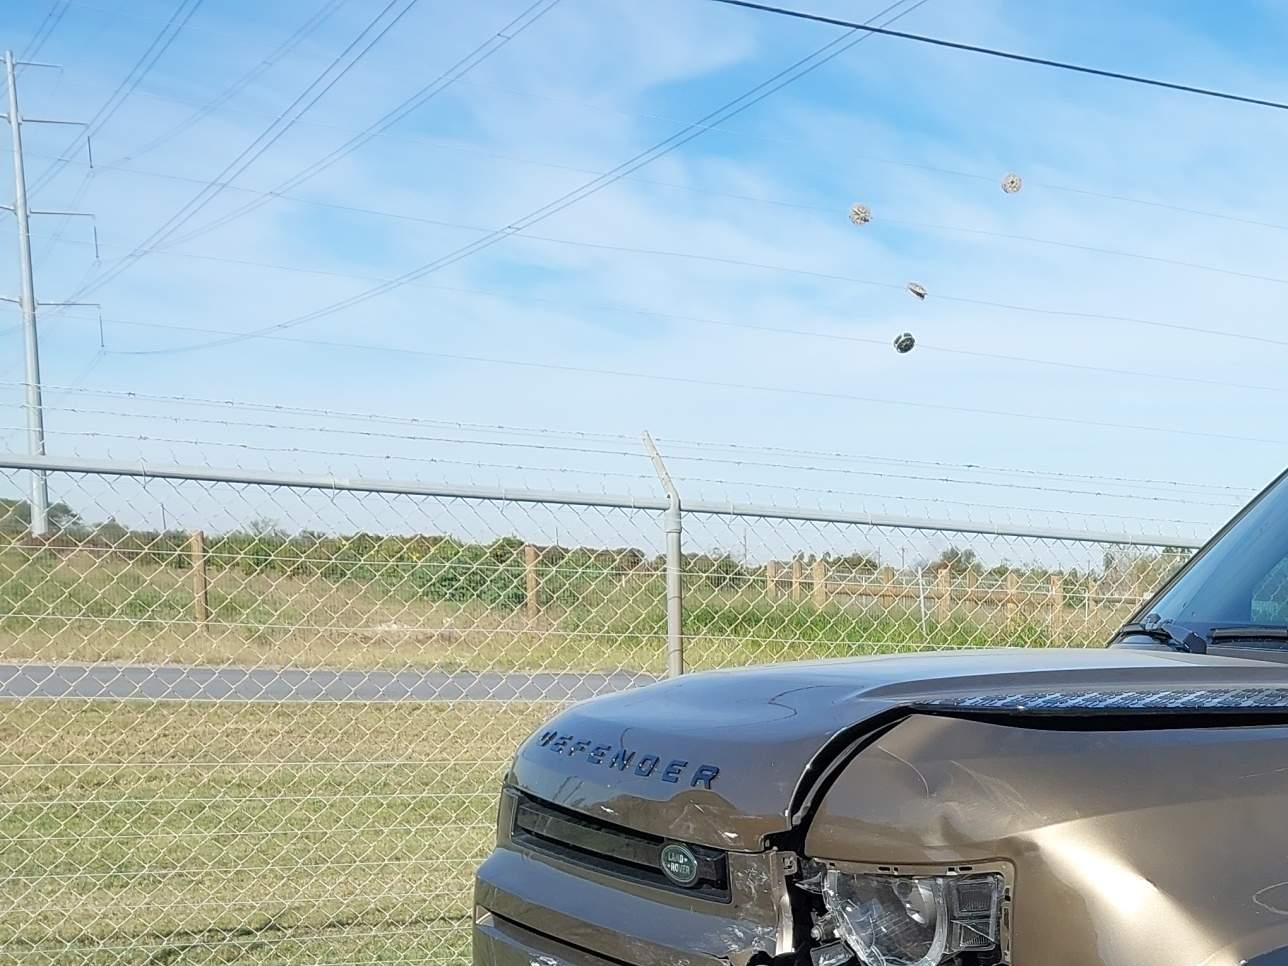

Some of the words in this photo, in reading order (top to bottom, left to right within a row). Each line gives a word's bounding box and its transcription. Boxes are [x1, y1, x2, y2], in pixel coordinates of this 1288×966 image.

[536, 731, 720, 790] DEFENDER
[667, 851, 684, 864] LAND
[670, 862, 691, 875] ROVER
